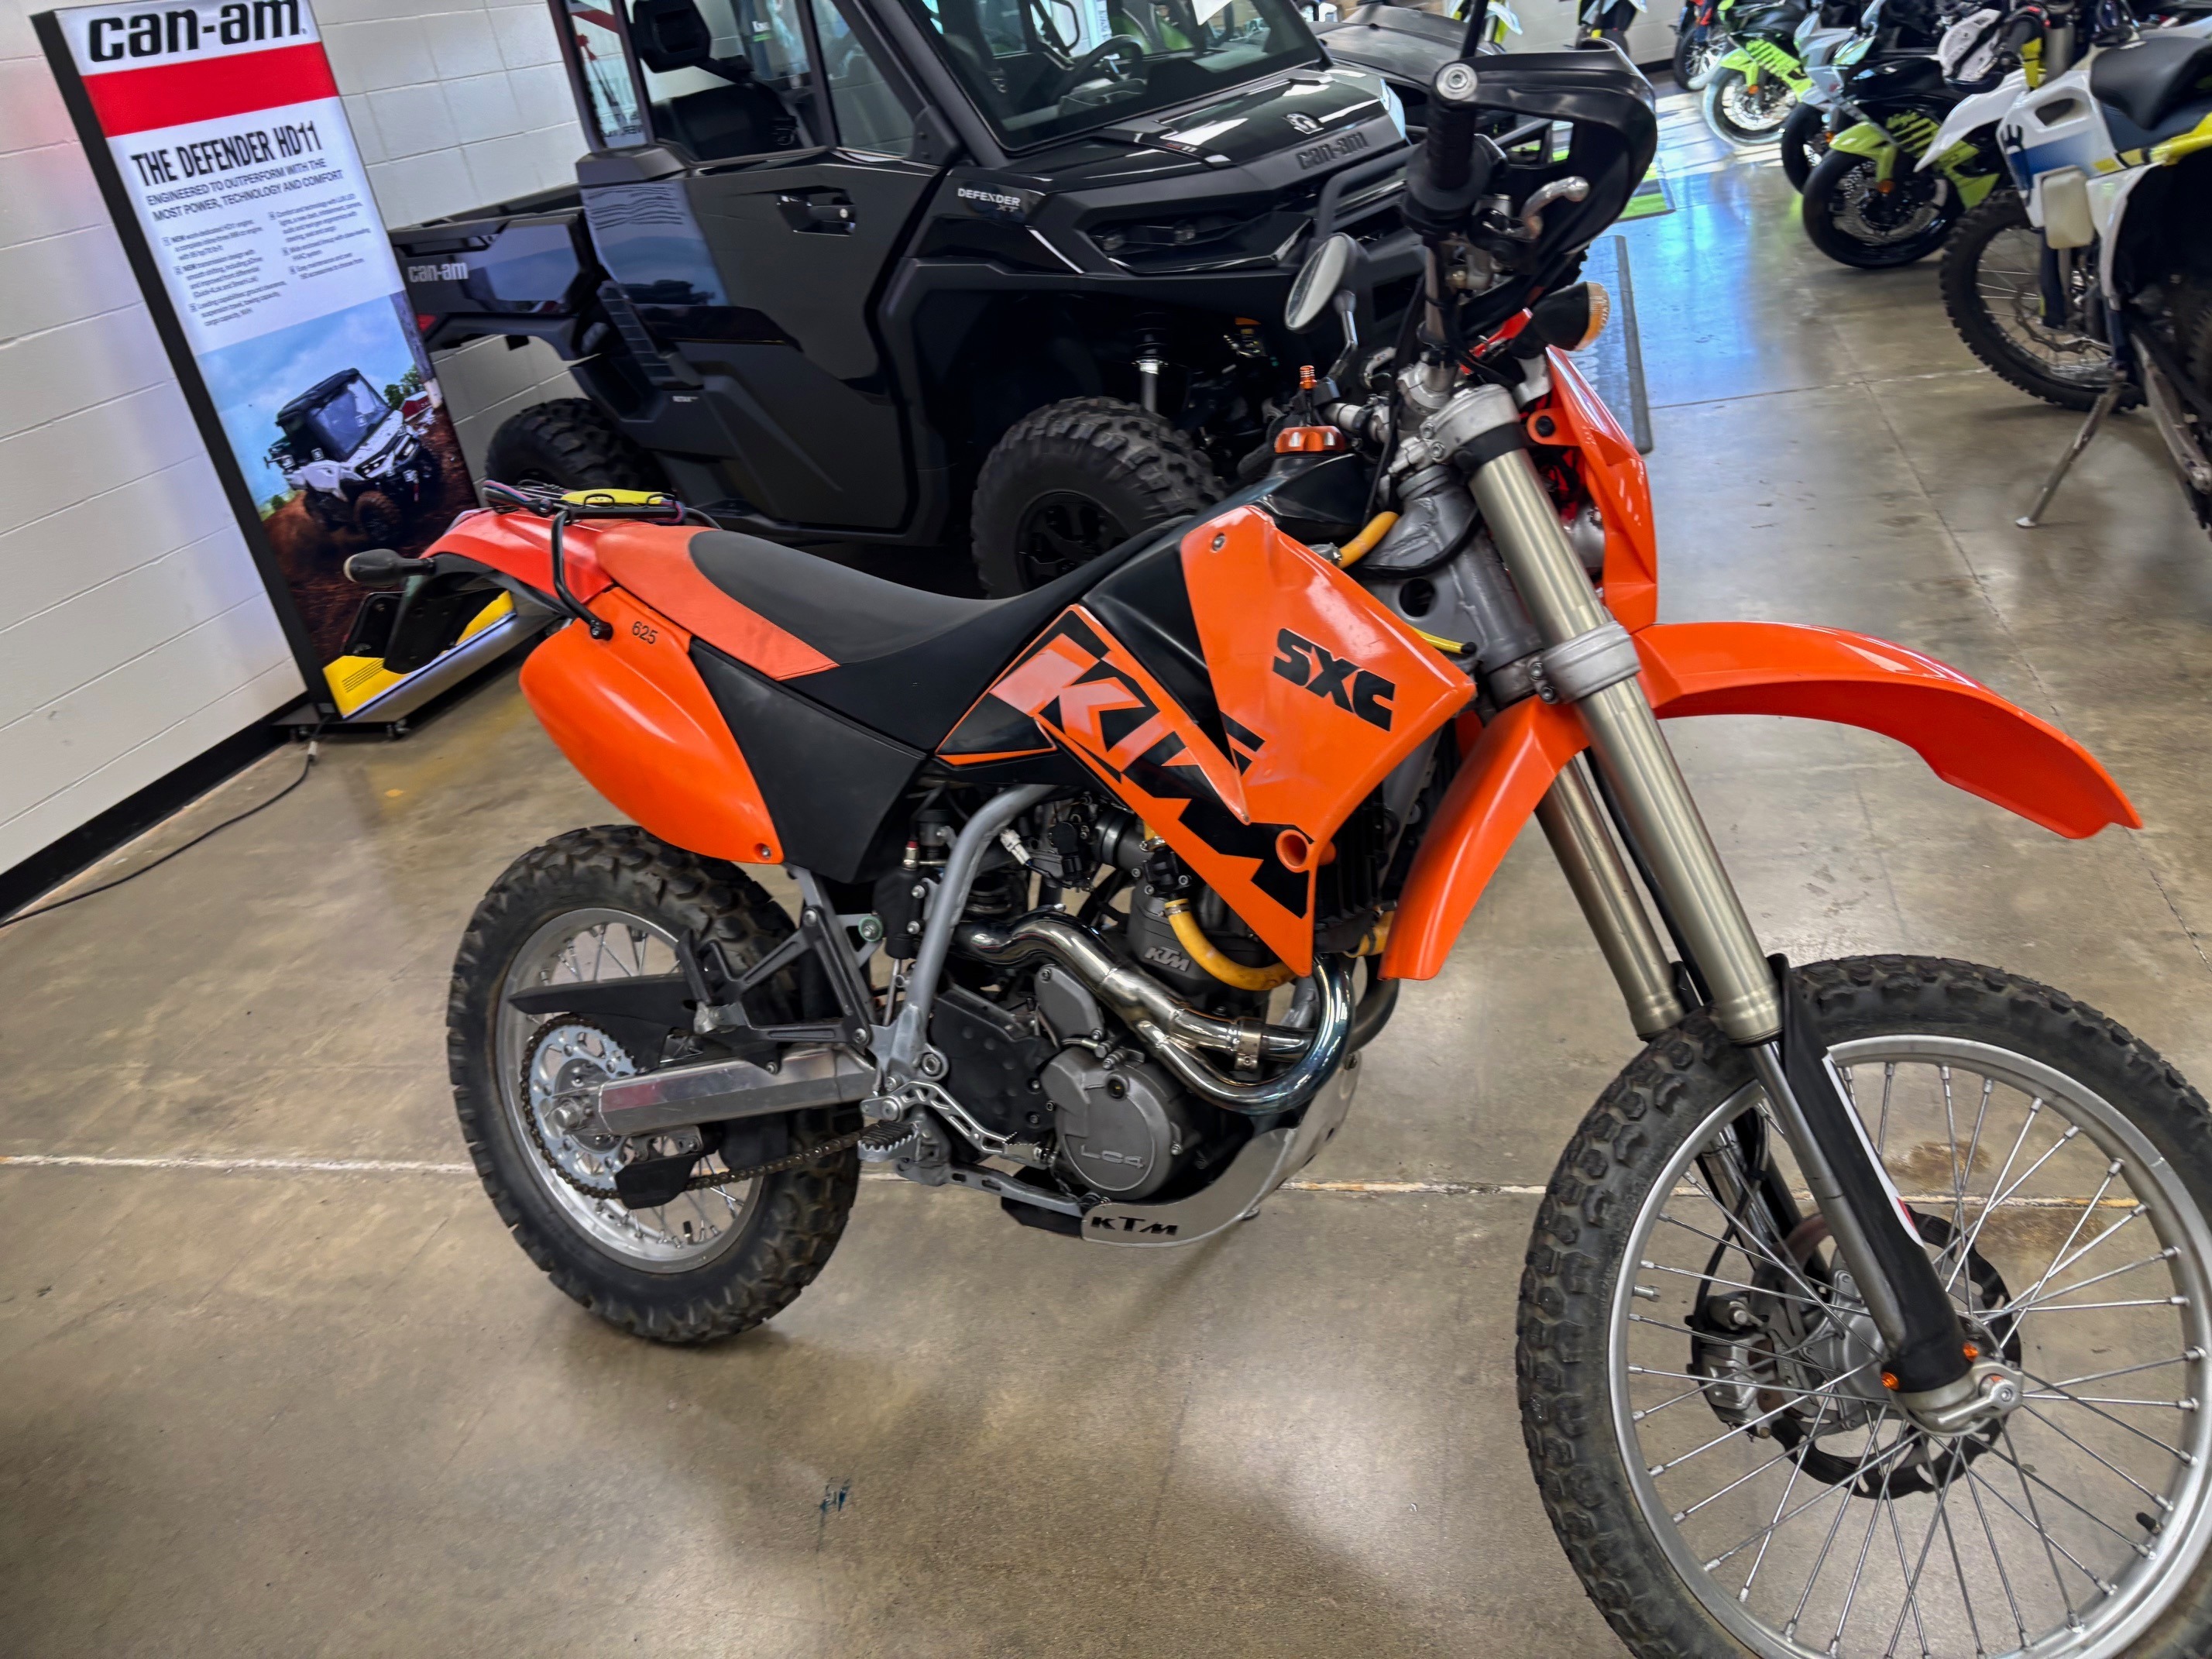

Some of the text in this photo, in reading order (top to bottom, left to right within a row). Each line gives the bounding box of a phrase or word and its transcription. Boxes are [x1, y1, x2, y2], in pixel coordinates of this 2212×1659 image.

[89, 0, 300, 63] can-am
[130, 120, 324, 187] THE DEFENDER HD11
[1296, 131, 1370, 170] can-am
[145, 157, 327, 206] ENGINEERED TO OUTPERFORM WITH THE
[152, 206, 184, 222] MOST
[184, 198, 223, 217] POWER,
[220, 184, 284, 206] TECHNOLOGY
[282, 177, 303, 191] AND
[301, 168, 345, 188] COMFORT
[957, 187, 1021, 207] DEFENDER
[407, 262, 469, 283] can-am
[632, 620, 658, 644] 625
[1273, 628, 1396, 732] SXC
[1145, 946, 1191, 972] KTM
[1091, 1216, 1179, 1236] KTM
